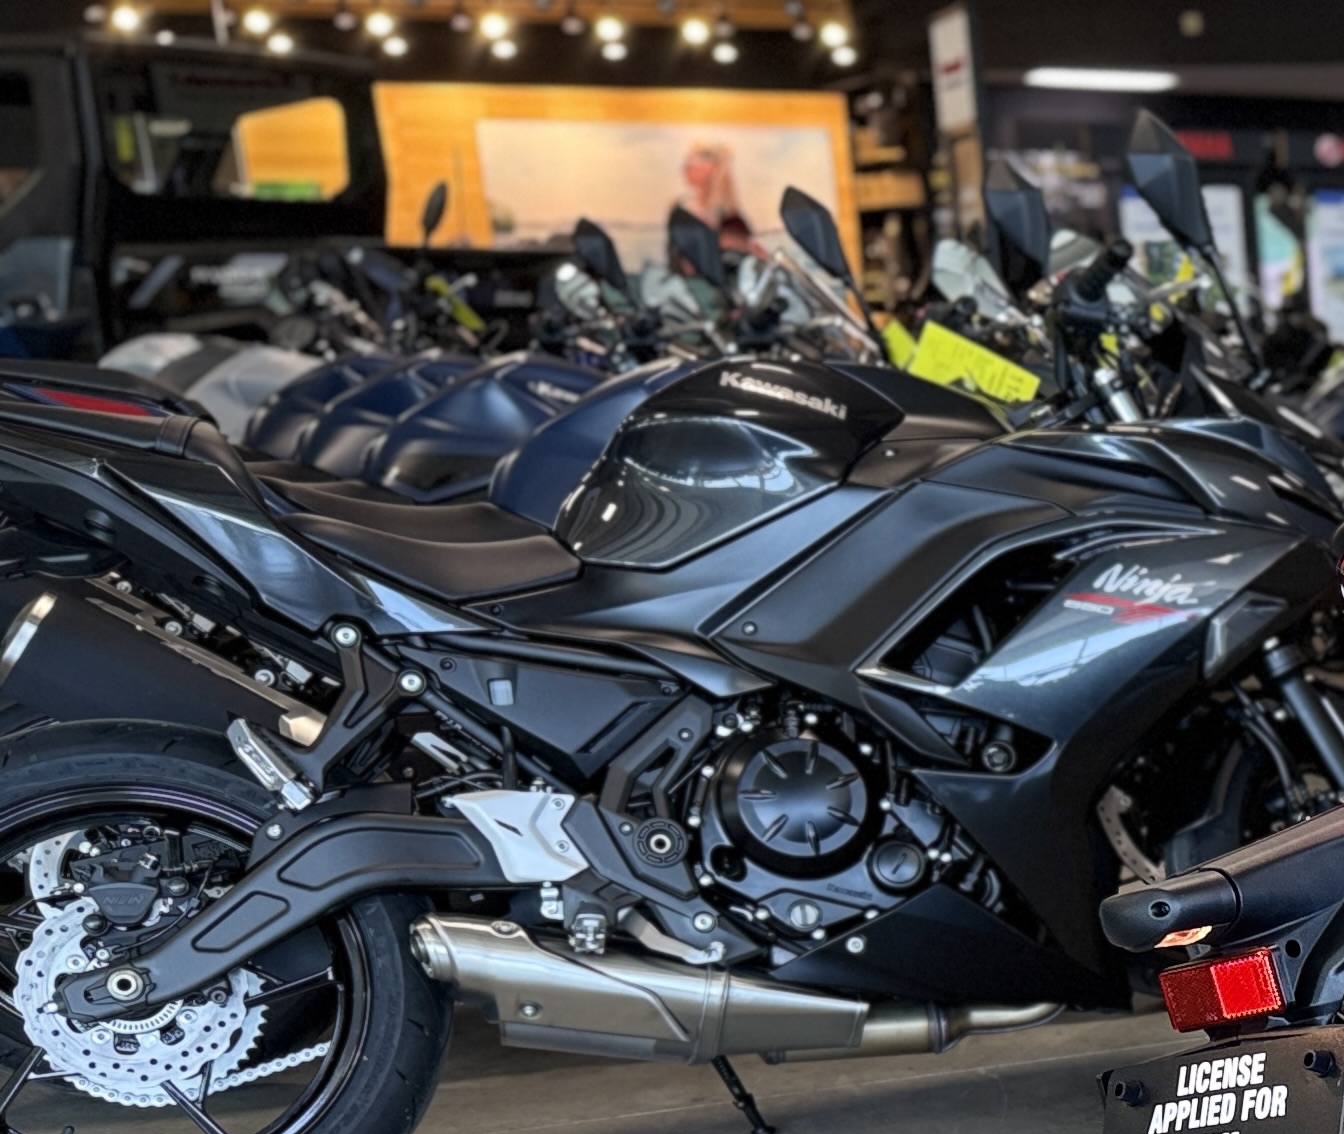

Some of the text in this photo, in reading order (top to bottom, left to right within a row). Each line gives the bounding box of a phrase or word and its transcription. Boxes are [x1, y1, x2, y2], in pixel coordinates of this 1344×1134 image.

[719, 371, 847, 420] Kawasaki
[1093, 563, 1199, 606] Ninja
[1177, 1053, 1266, 1096] LICENSE
[1148, 1085, 1288, 1134] APPLIED FOR
